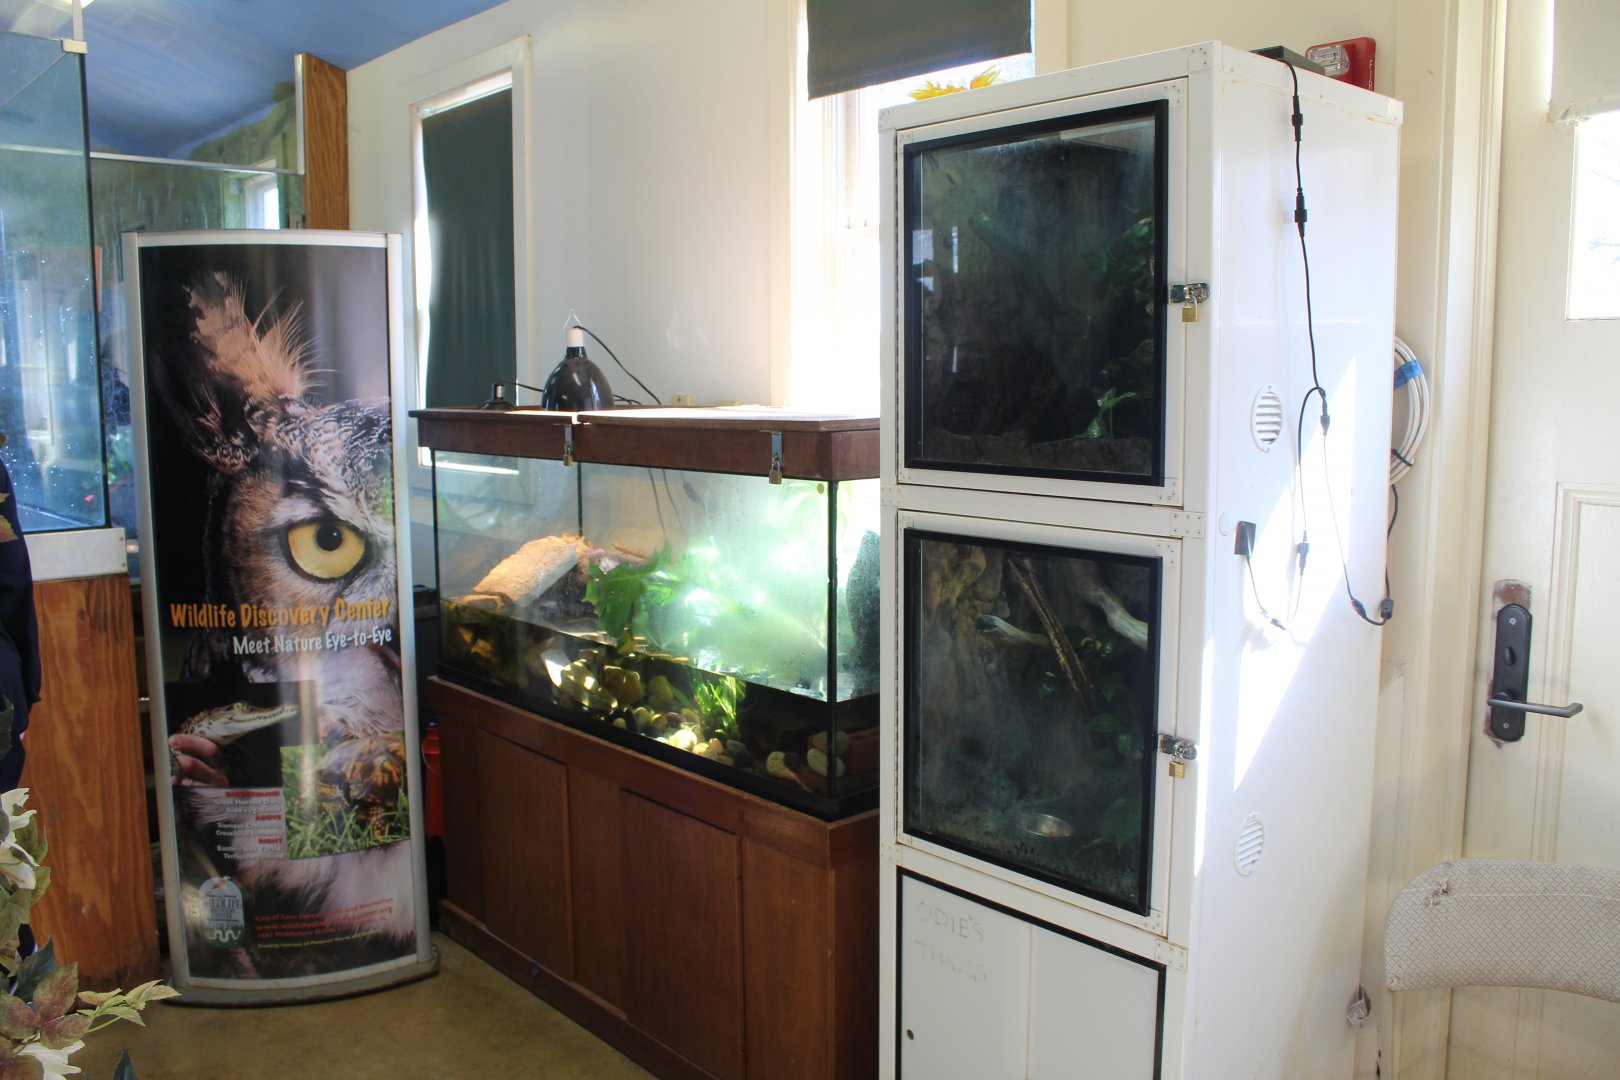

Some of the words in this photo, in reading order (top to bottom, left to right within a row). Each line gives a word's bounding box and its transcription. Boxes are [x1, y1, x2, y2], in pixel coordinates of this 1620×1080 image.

[171, 603, 236, 628] Wildlife
[241, 603, 330, 629] Discovery
[335, 597, 390, 620] Center
[233, 636, 270, 655] Meet
[274, 634, 322, 653] Nature
[325, 624, 392, 652] Eye-to-Eye
